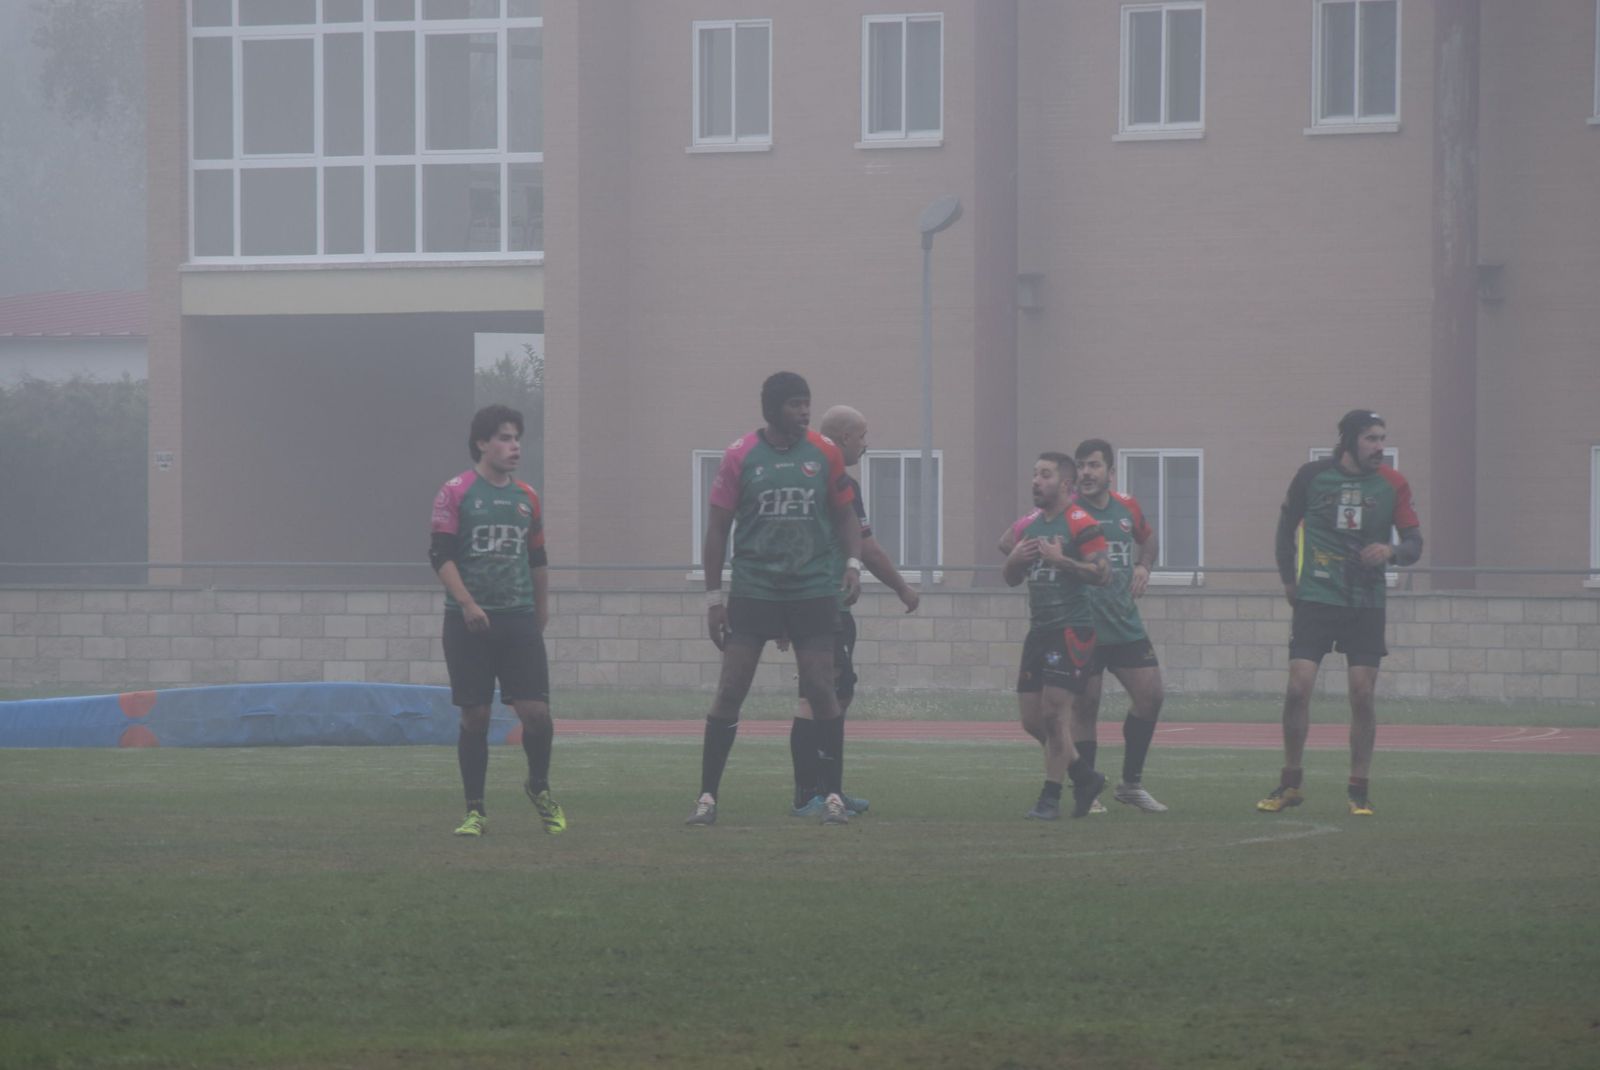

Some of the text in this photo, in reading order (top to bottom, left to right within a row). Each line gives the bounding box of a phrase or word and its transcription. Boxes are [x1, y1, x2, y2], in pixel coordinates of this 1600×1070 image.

[758, 487, 815, 502] CITY
[758, 500, 815, 515] LIFT
[472, 524, 528, 540] CITY
[472, 538, 524, 554] LIFT
